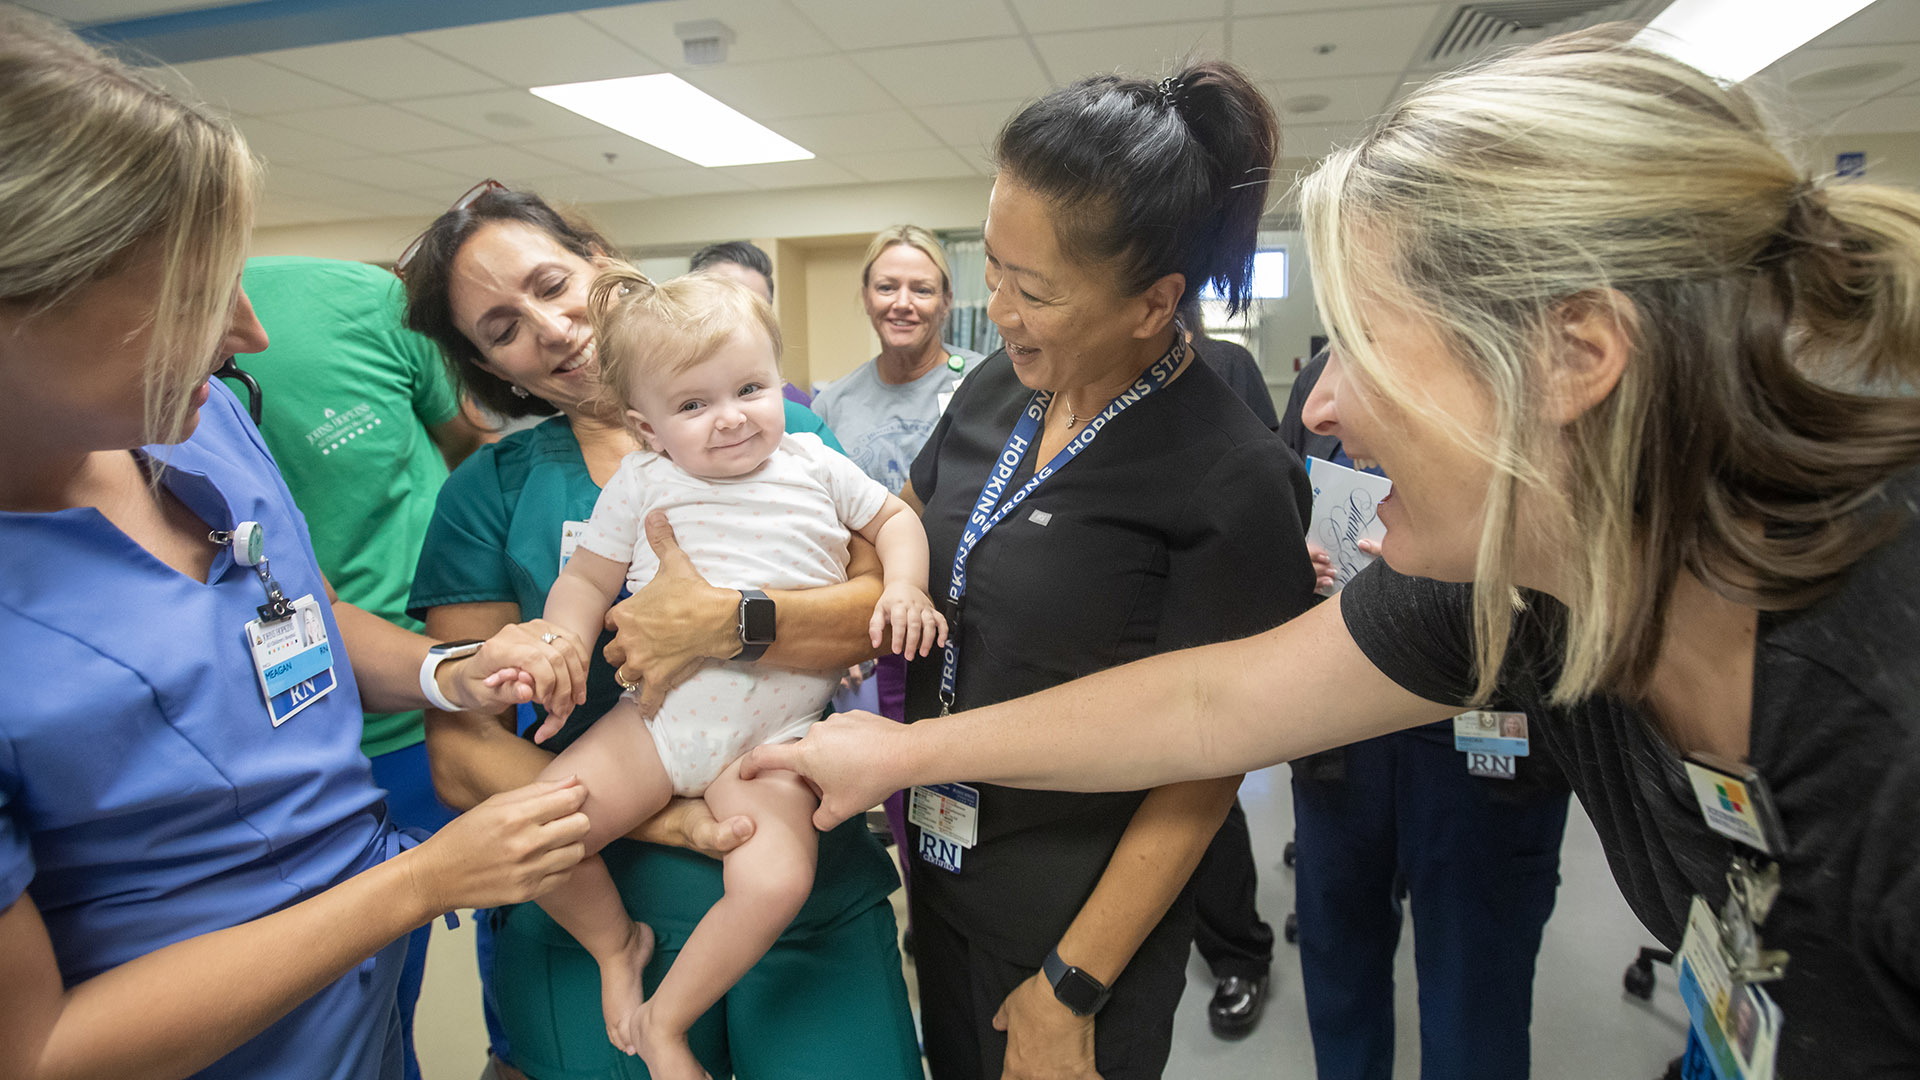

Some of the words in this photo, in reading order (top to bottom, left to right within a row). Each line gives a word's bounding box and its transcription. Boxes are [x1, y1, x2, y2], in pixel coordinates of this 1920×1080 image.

[971, 435, 1028, 526] HOPKINS
[981, 467, 1054, 534] STRONG
[319, 645, 328, 655] RN
[265, 661, 293, 680] MEAGAN
[290, 679, 316, 707] RN
[1472, 753, 1511, 773] RN
[921, 832, 958, 868] RN
